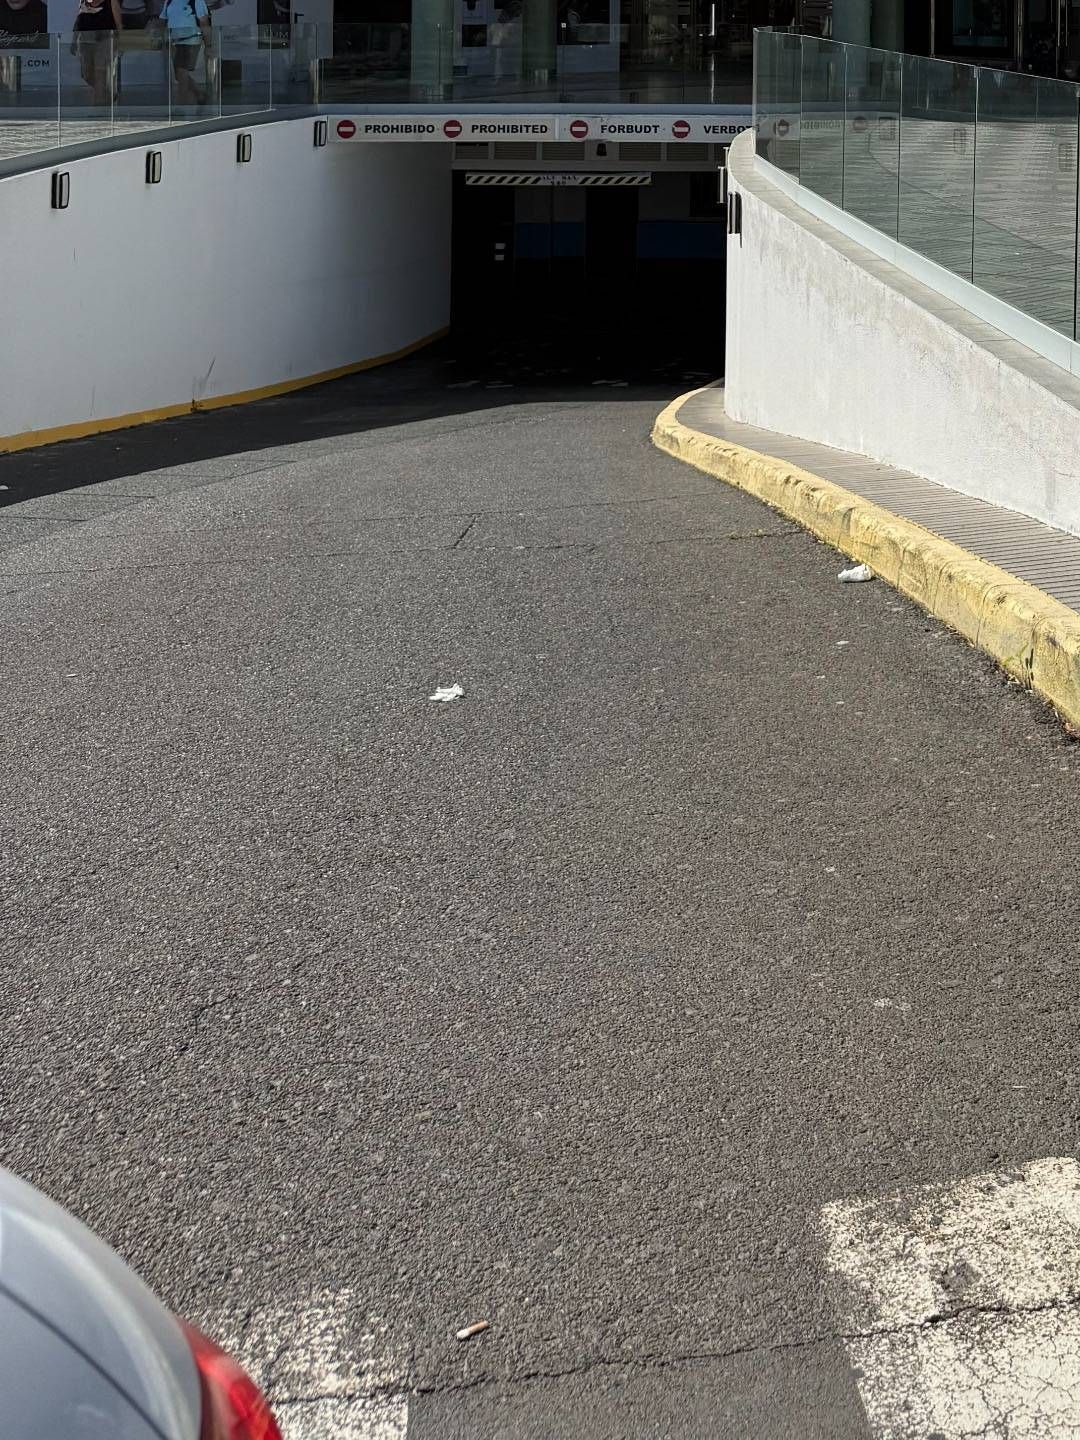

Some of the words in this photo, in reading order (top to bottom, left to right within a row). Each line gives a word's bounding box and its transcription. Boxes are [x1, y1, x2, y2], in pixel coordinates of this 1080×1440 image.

[364, 124, 436, 134] PROHIBIDO
[471, 124, 549, 134] PROHIBITED
[600, 124, 660, 134] FORBUDT
